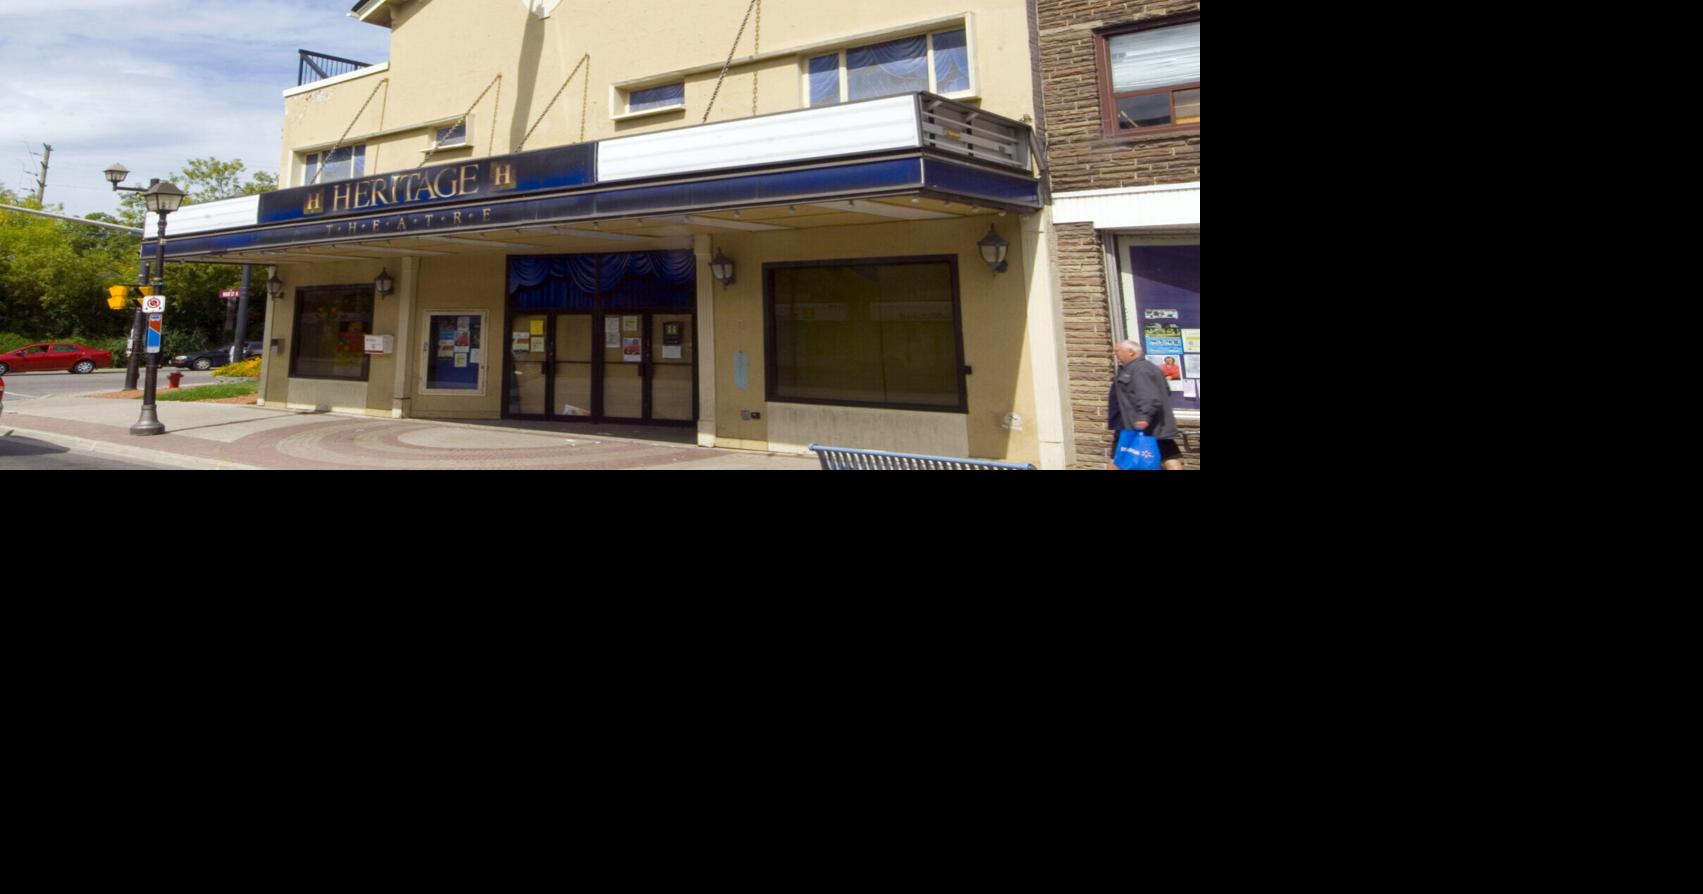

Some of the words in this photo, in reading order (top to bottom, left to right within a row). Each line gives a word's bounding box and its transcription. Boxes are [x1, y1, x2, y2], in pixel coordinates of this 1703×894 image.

[307, 194, 322, 210] H
[333, 165, 479, 211] HERITAGE
[494, 164, 511, 186] H
